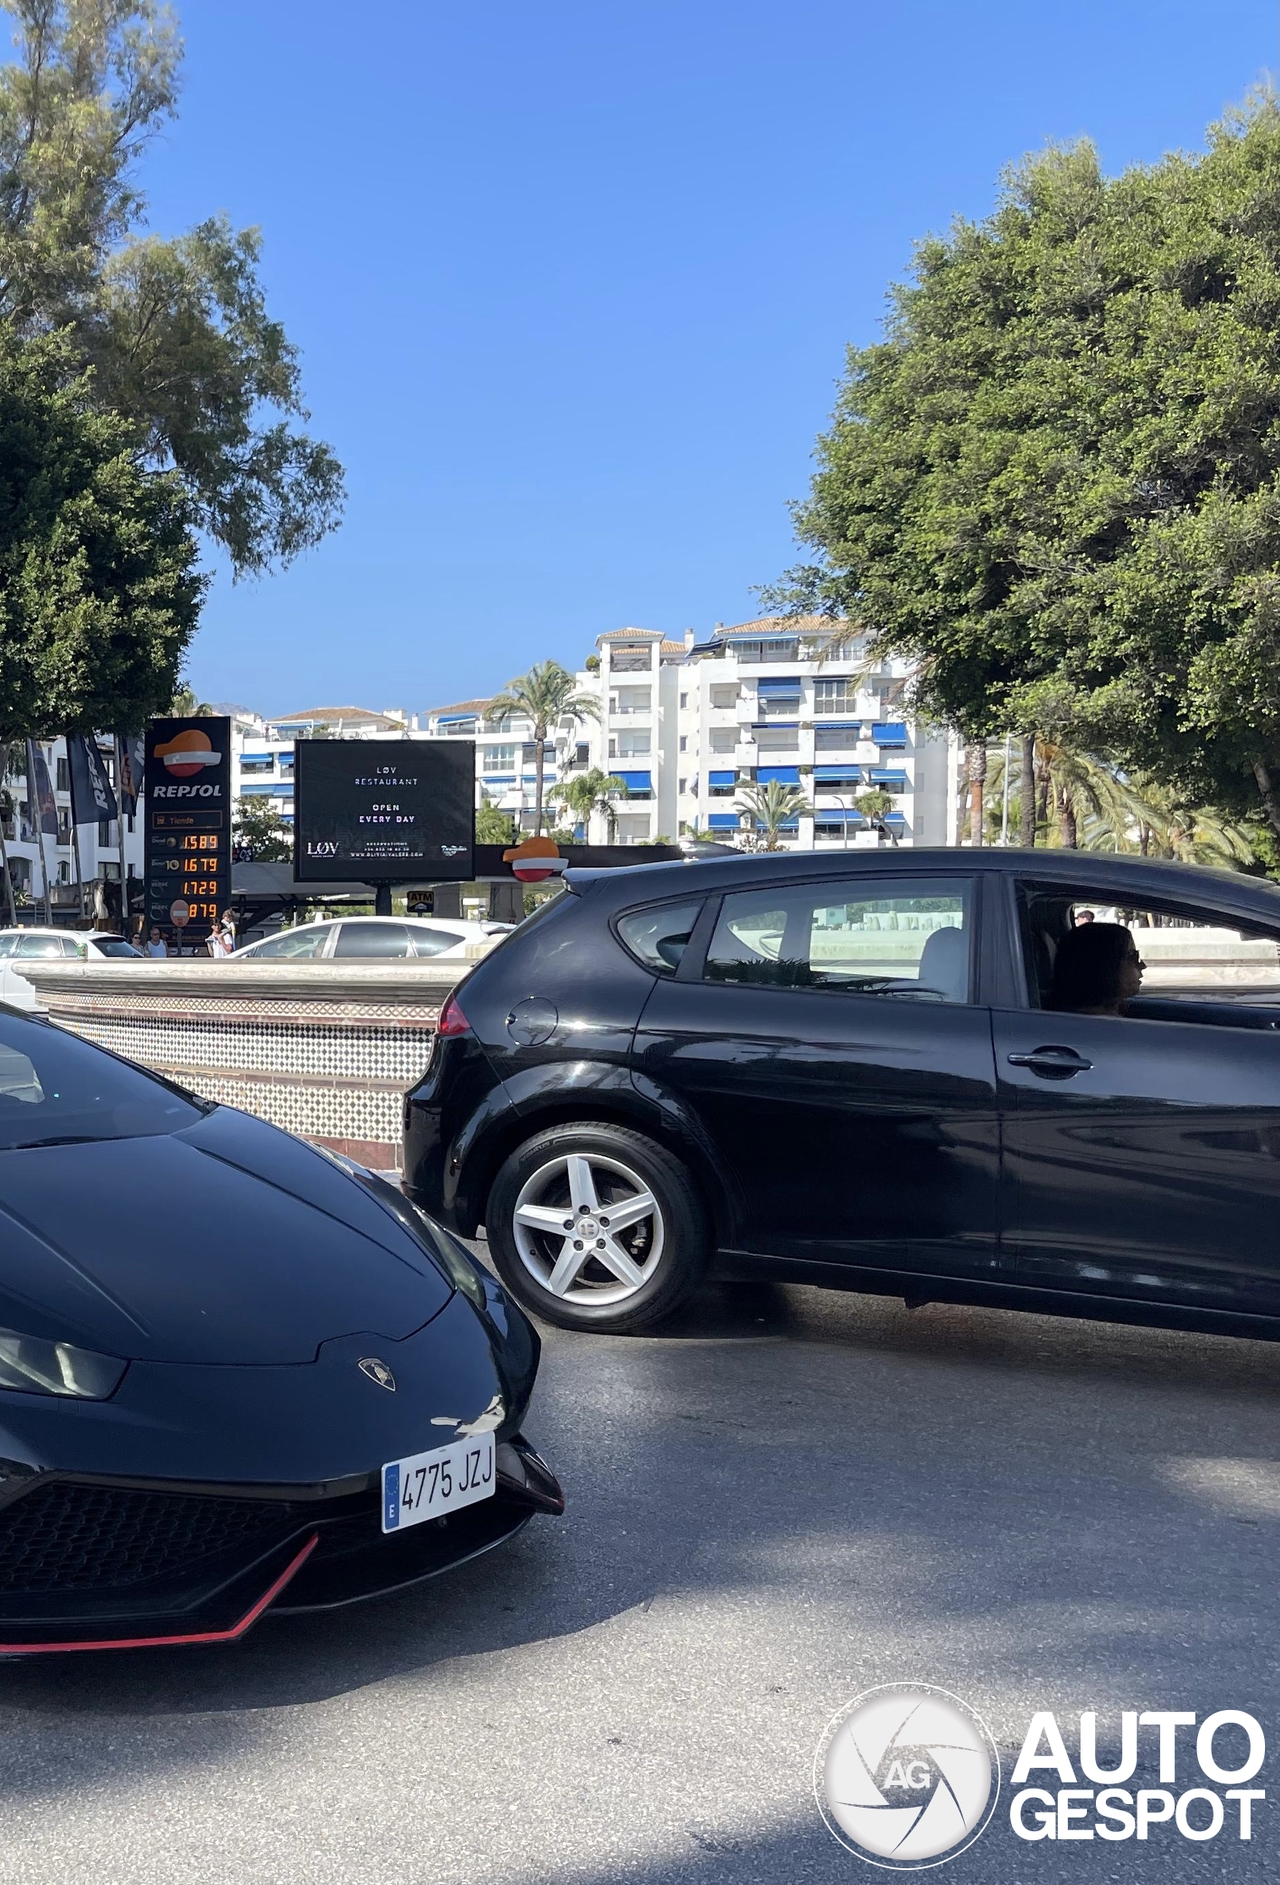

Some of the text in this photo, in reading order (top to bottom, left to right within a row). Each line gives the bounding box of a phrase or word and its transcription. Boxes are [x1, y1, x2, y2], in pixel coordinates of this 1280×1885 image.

[355, 778, 418, 786] RESTAURANT
[153, 784, 222, 798] REPSOL
[372, 804, 400, 812] OPEN
[307, 842, 339, 855] LØV
[183, 881, 217, 895] 1.729
[411, 892, 432, 902] ATM
[402, 1446, 492, 1510] 4775 JZJ
[389, 1504, 395, 1519] E
